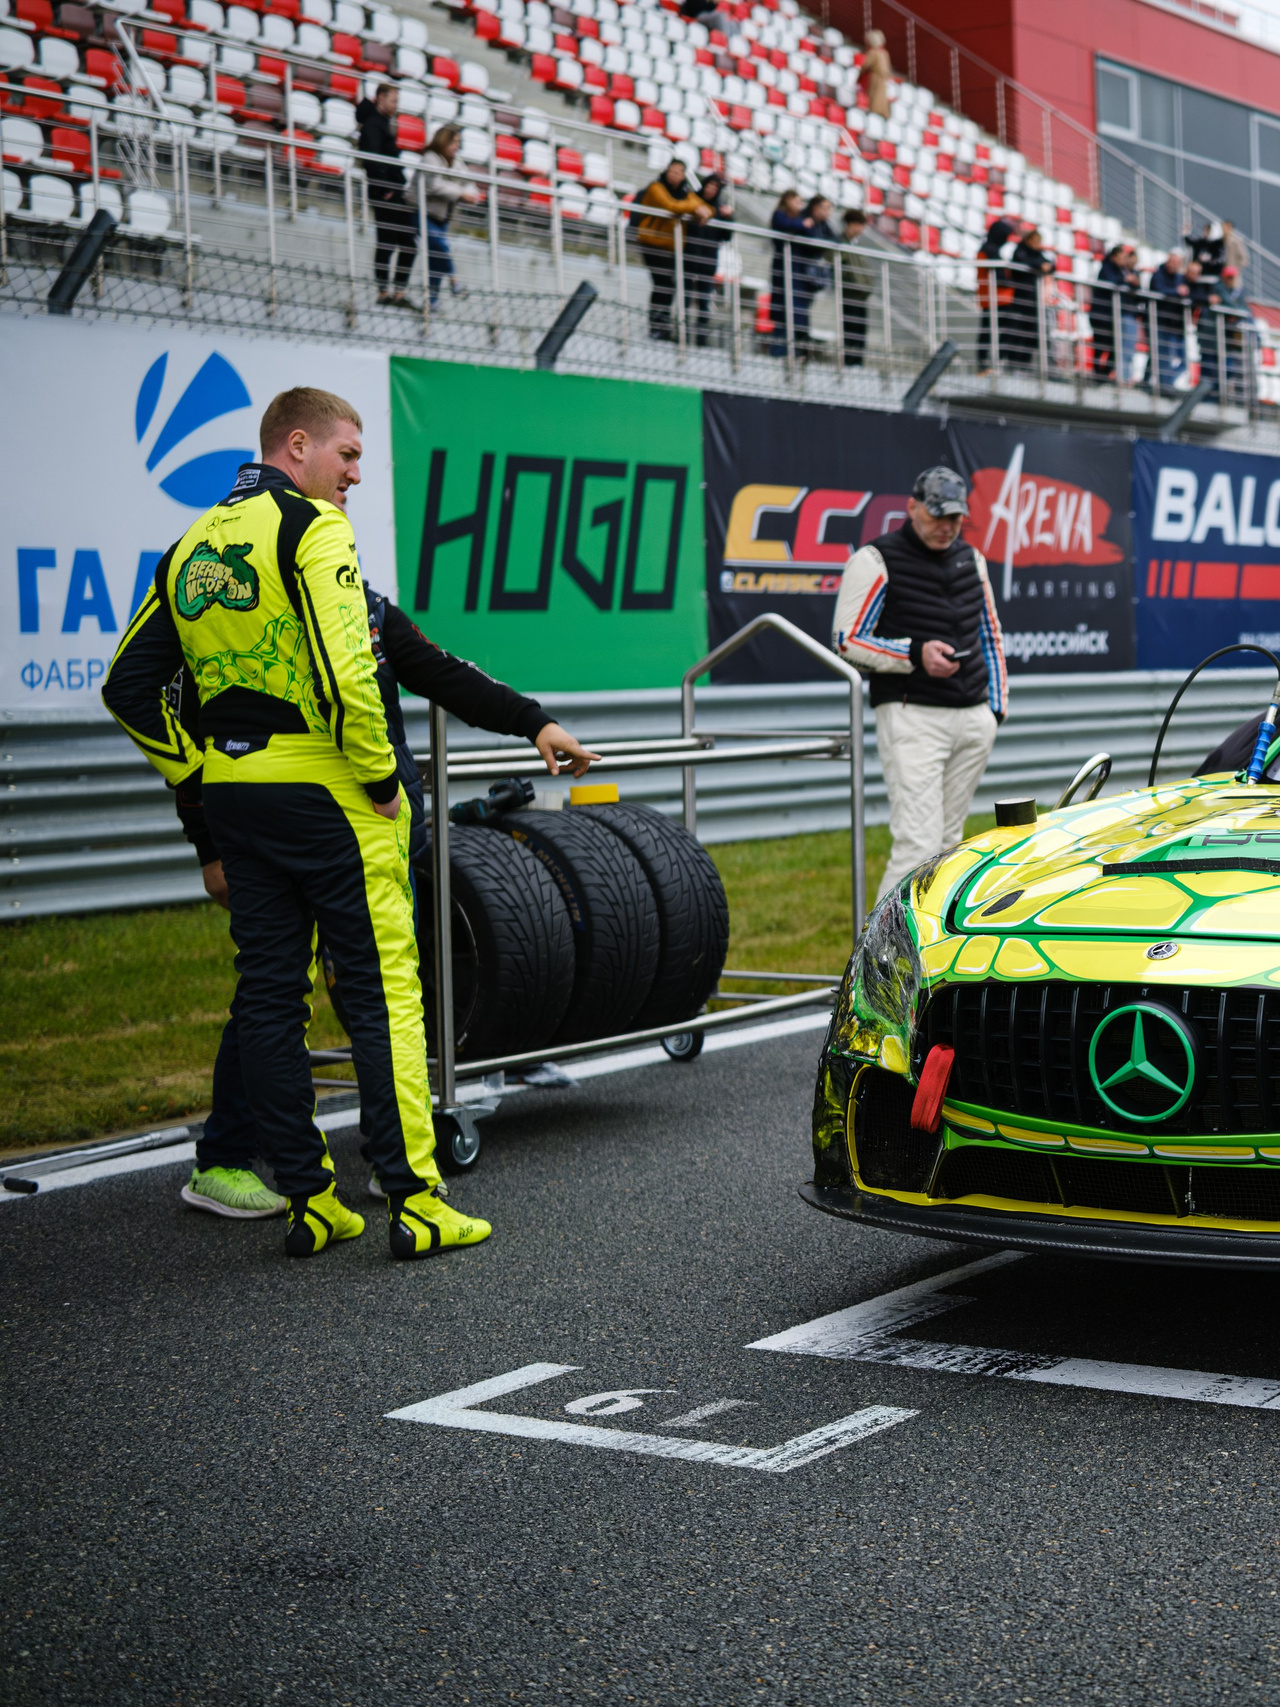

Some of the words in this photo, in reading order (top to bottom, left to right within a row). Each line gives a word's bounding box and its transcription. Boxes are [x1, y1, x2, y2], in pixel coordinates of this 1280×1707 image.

[414, 449, 688, 612] HOGO
[983, 443, 1093, 602] ARENA
[187, 560, 233, 581] BEAST
[1012, 580, 1117, 600] KARTING
[21, 659, 111, 691] ФАБР
